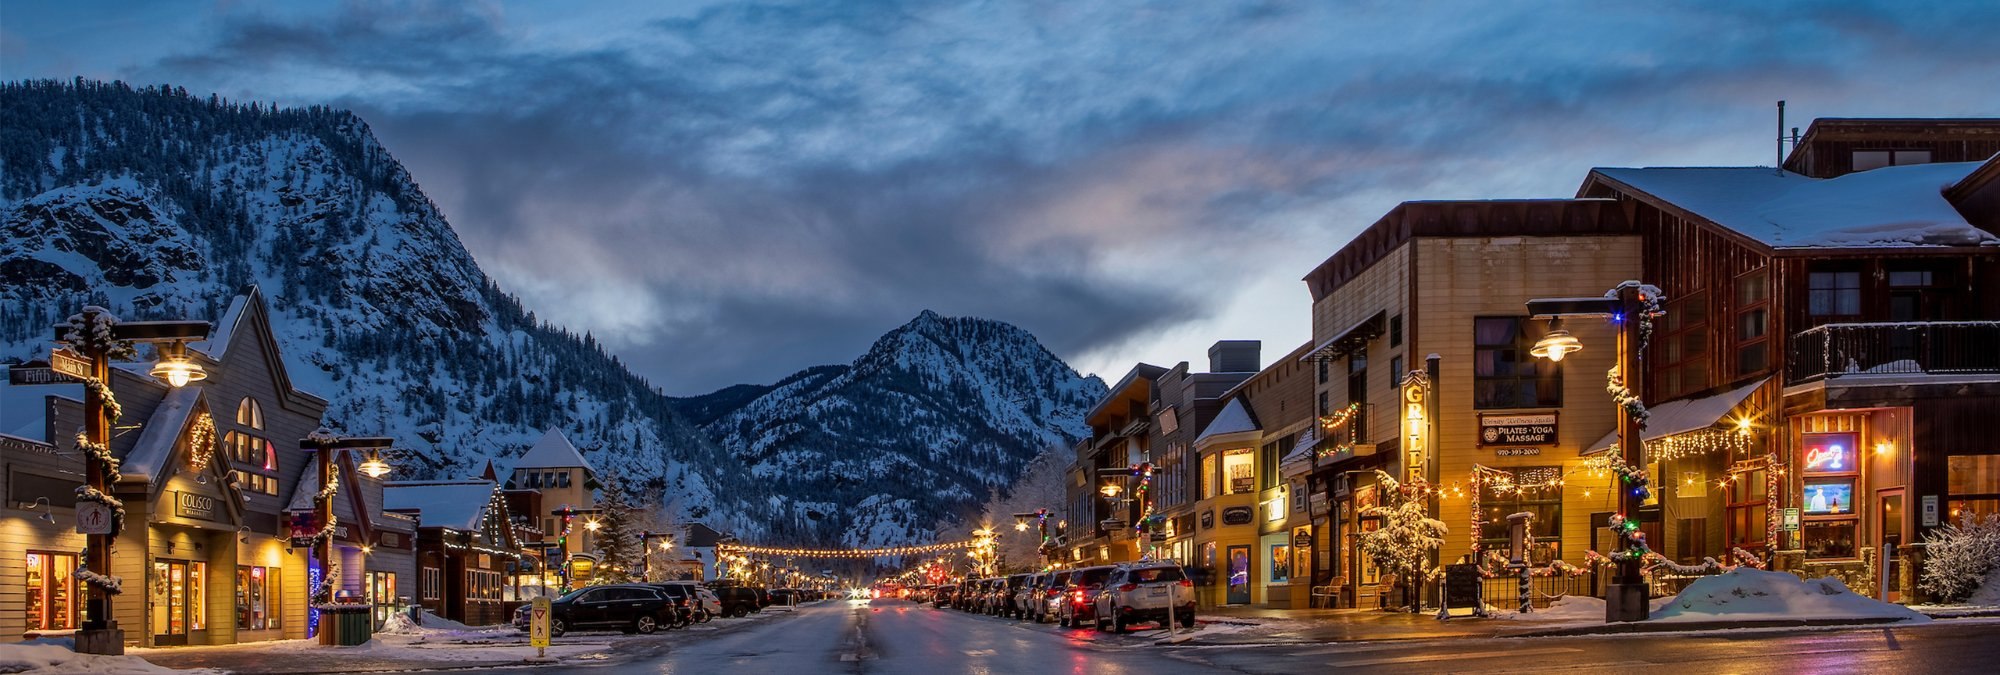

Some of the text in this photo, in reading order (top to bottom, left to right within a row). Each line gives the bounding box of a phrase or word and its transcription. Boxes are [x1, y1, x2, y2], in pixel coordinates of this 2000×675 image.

[62, 358, 84, 375] Main St
[25, 369, 50, 382] Fifth
[1498, 427, 1528, 435] PILATES
[1506, 434, 1545, 442] MASSAGE
